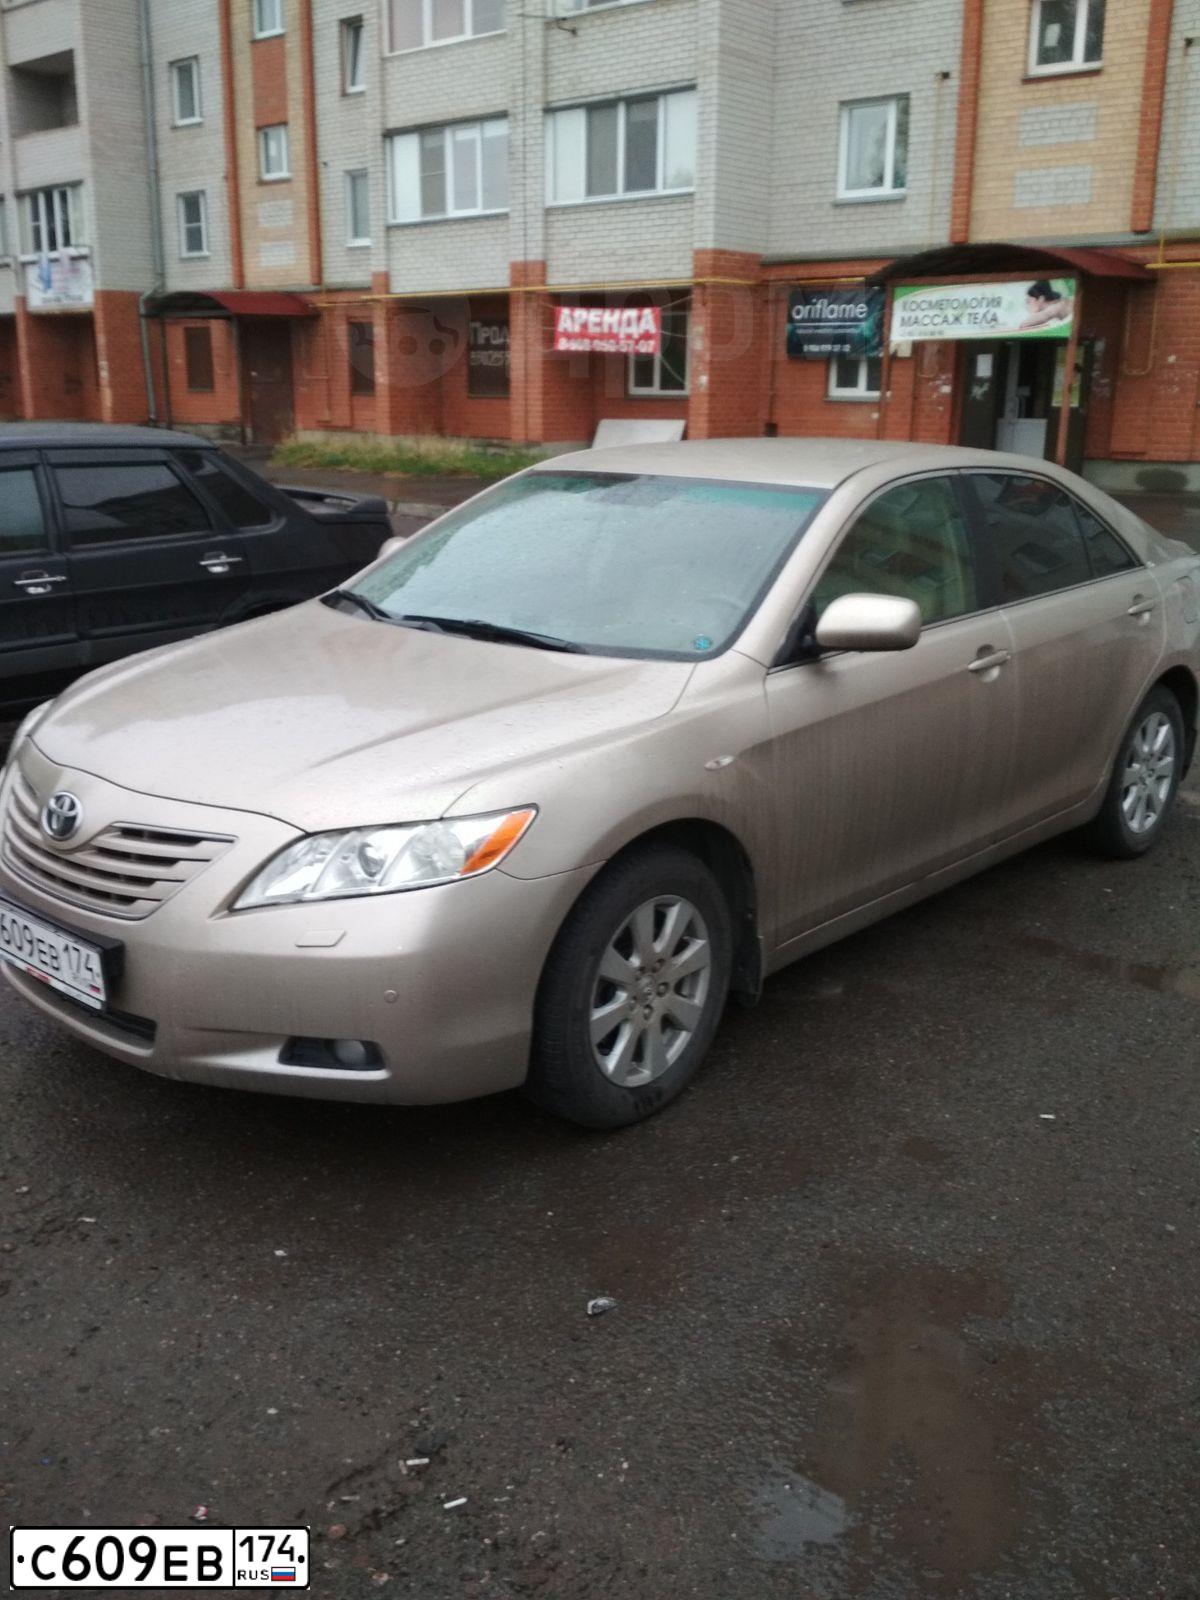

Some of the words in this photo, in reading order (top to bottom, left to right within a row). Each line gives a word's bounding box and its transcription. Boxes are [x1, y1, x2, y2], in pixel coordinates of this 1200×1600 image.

[792, 298, 868, 319] oriflame
[901, 295, 1003, 312] КОСМЕТОЛОГИЯ
[557, 306, 657, 339] АРЕНДА
[899, 313, 963, 328] МАССАЖ
[967, 309, 999, 326] ТЕЛА
